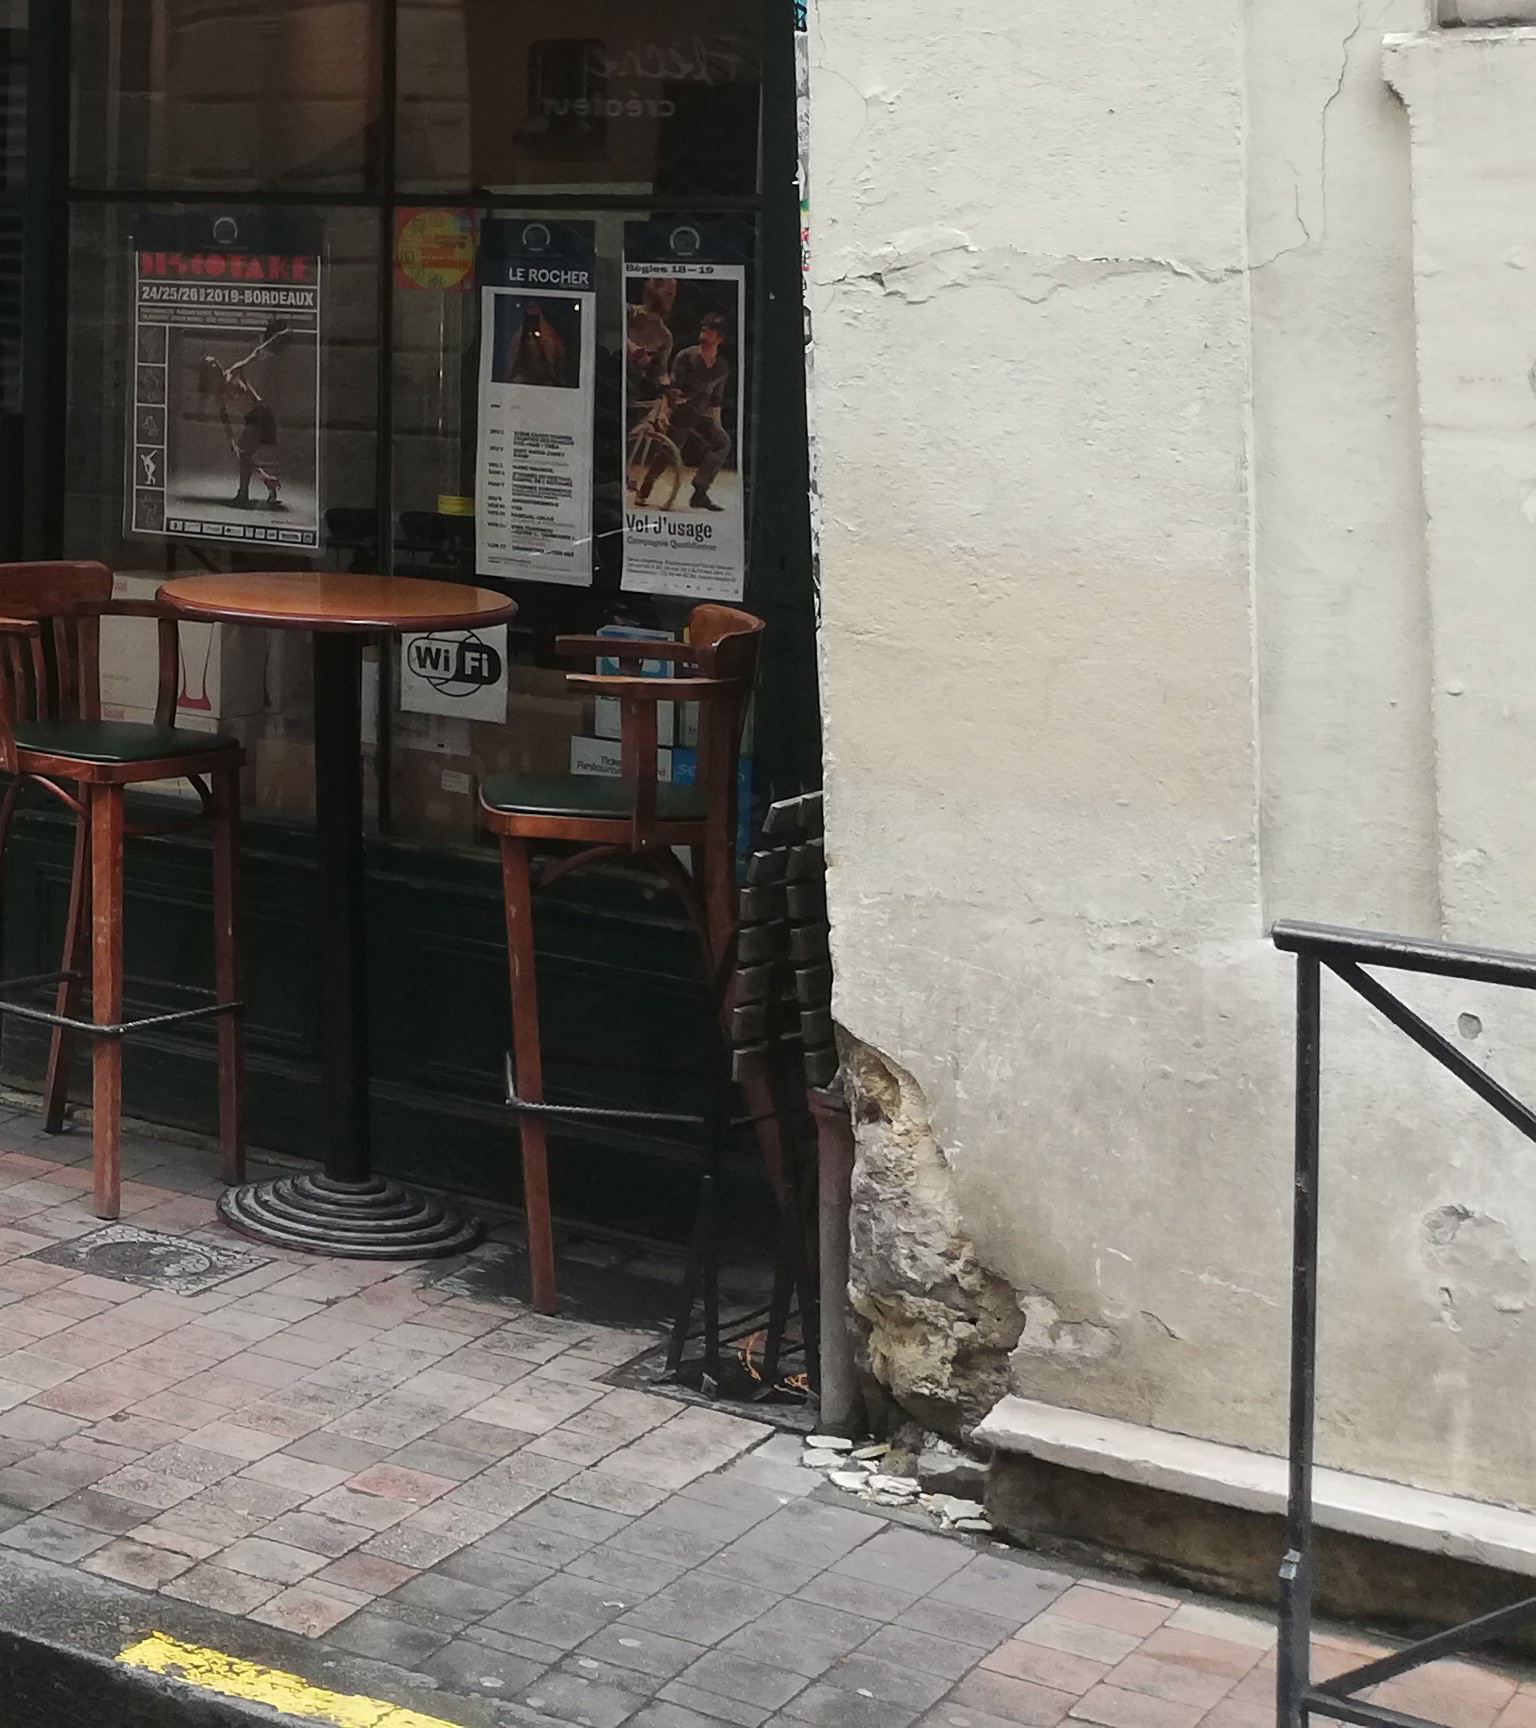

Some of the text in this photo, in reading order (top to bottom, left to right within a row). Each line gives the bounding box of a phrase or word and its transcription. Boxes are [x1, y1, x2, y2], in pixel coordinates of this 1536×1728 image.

[508, 267, 589, 285] LE ROCHER
[625, 513, 712, 542] Vol d'usage
